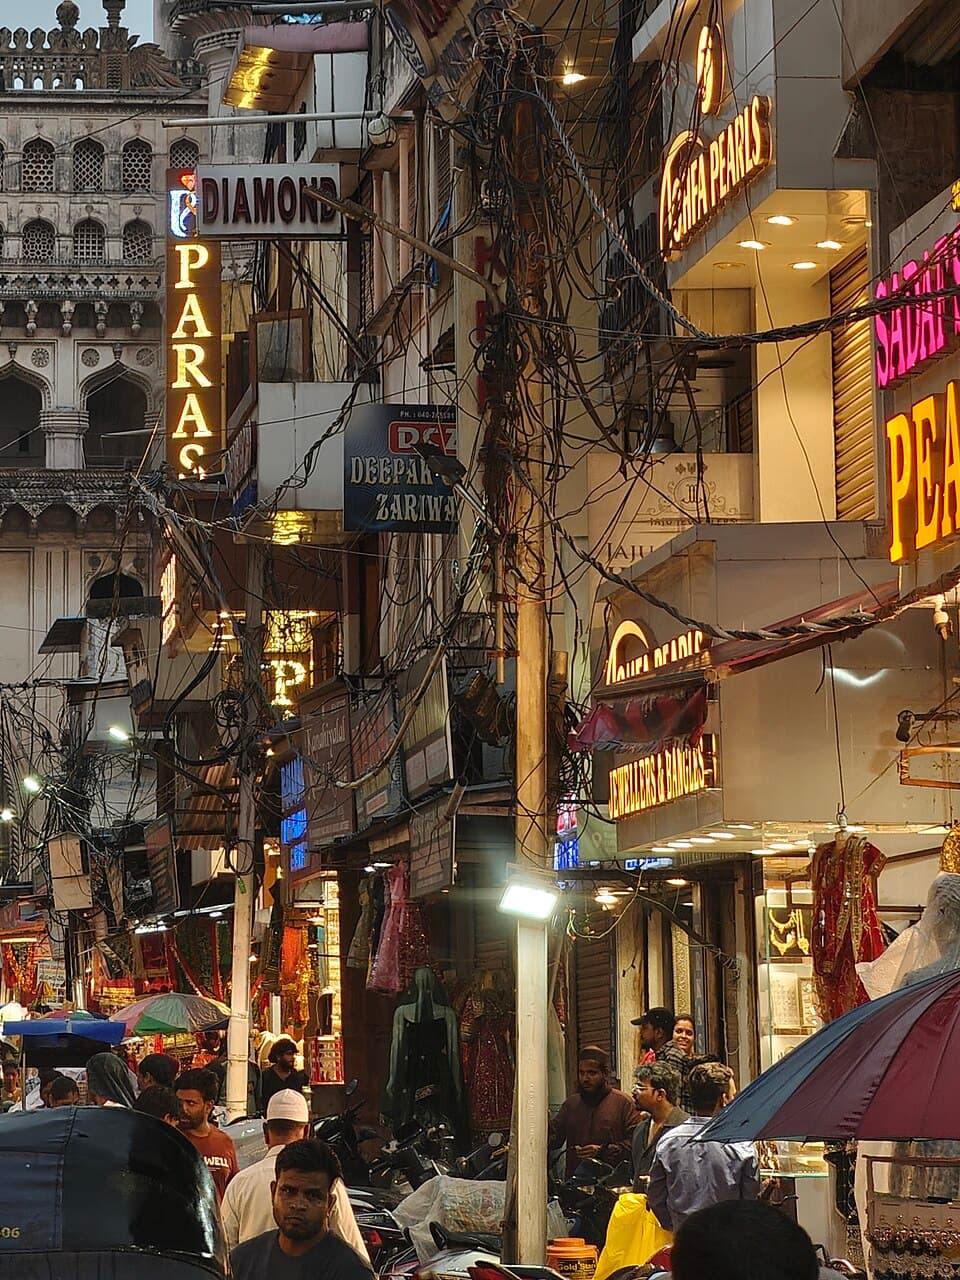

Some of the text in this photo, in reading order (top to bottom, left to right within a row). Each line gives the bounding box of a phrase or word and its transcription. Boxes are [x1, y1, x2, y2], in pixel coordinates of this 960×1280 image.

[709, 95, 764, 208] PEARLS
[201, 176, 337, 225] DIAMOND
[171, 243, 213, 481] PARAS
[608, 754, 657, 819] JEWELLERS
[665, 737, 706, 801] BANGLES
